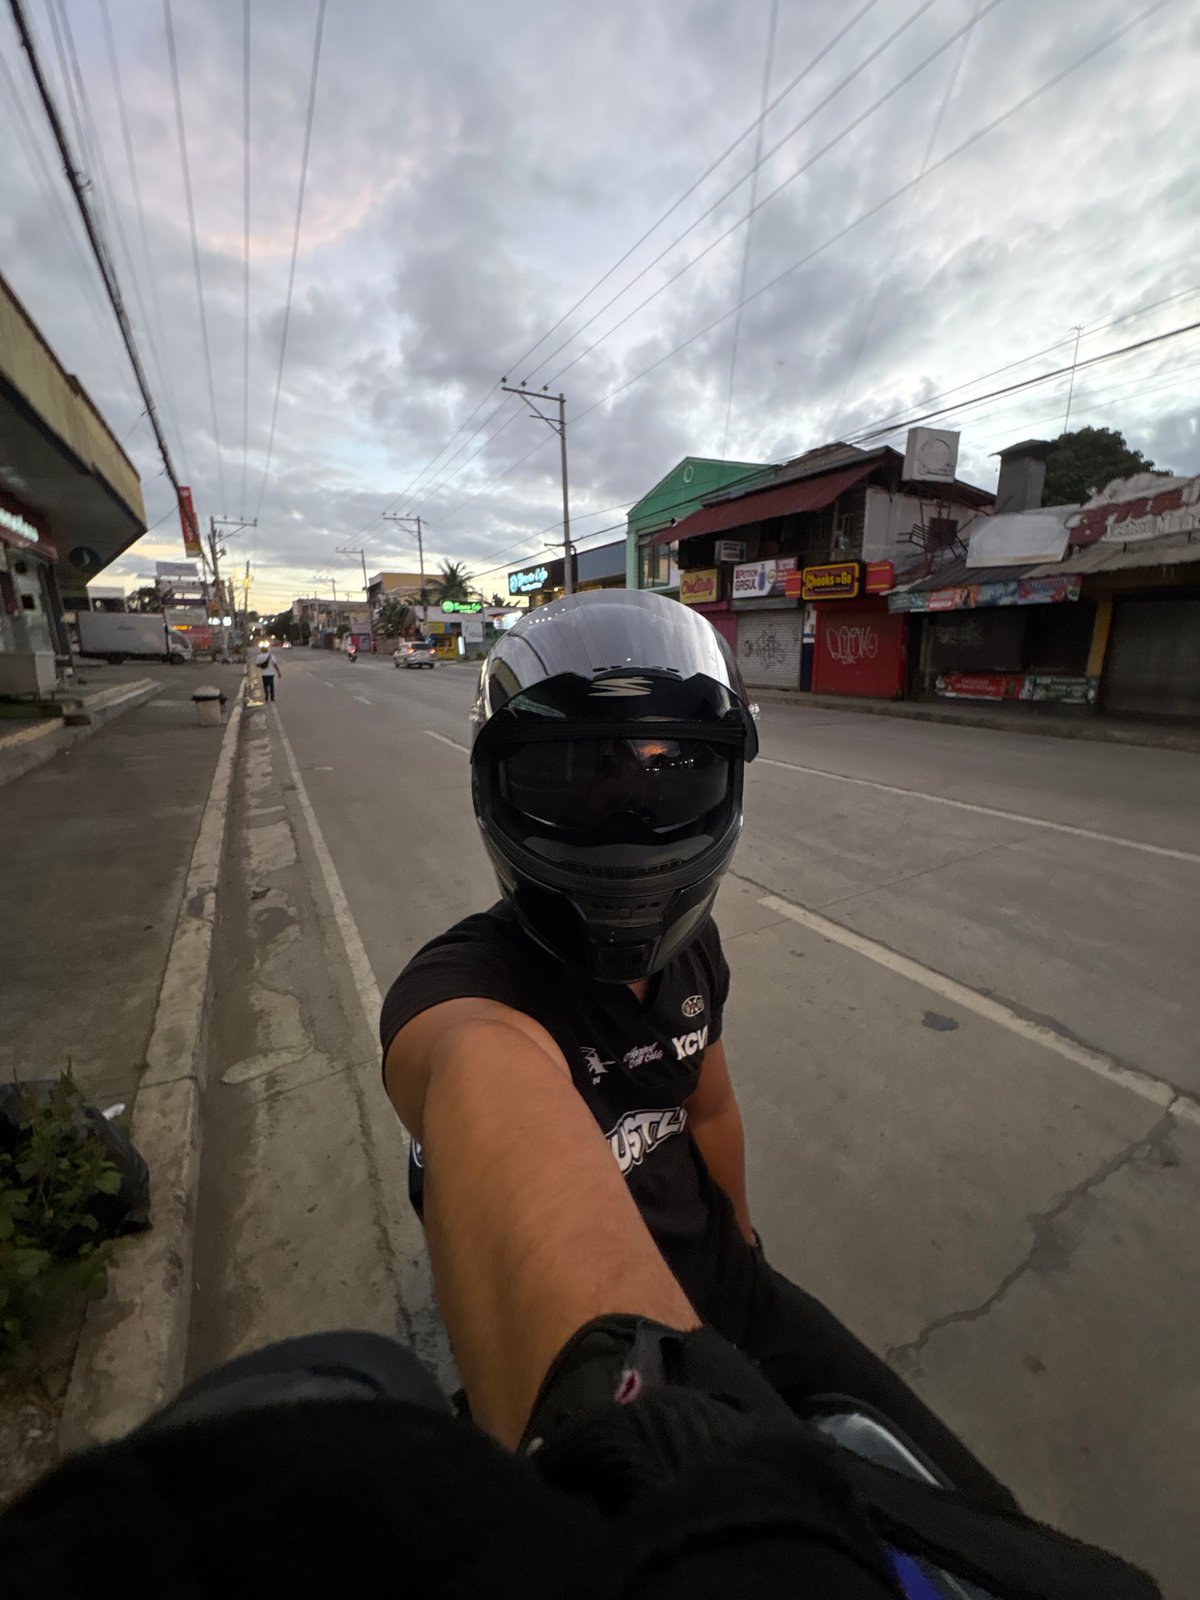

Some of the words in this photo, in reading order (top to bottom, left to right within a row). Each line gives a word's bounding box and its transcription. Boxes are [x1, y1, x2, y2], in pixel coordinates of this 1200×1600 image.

[735, 579, 757, 591] GASUL
[840, 571, 852, 585] Go
[606, 1107, 687, 1175] USTL
